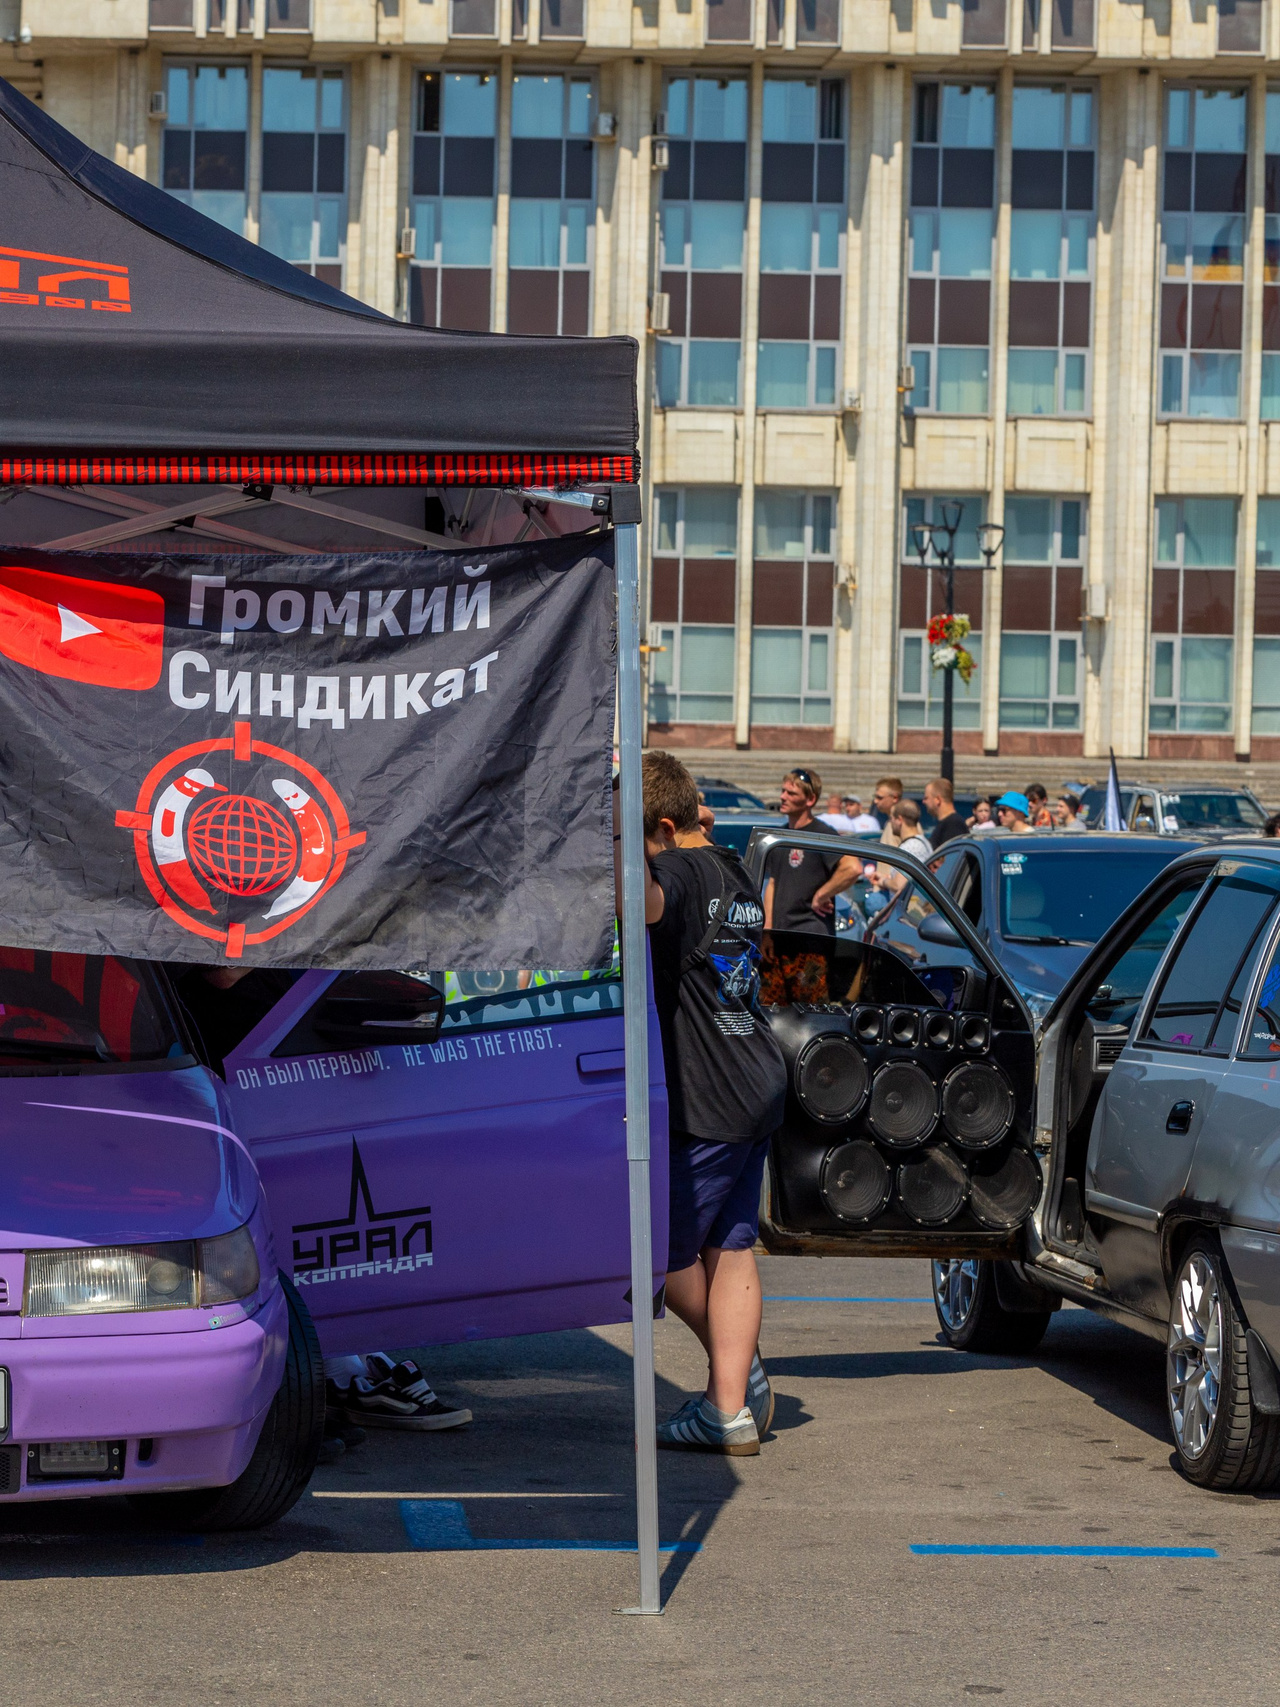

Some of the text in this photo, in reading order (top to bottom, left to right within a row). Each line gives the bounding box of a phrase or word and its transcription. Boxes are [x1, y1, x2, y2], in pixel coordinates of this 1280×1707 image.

[188, 564, 492, 645] Громкий
[168, 650, 499, 729] Синдикат
[236, 1050, 391, 1090] ОН БЫЛ ПЕРВЫМ.
[402, 1026, 563, 1068] HE WAS THE FIRST.
[292, 1219, 433, 1273] УРАЛ
[293, 1252, 434, 1287] КОМАНДА
